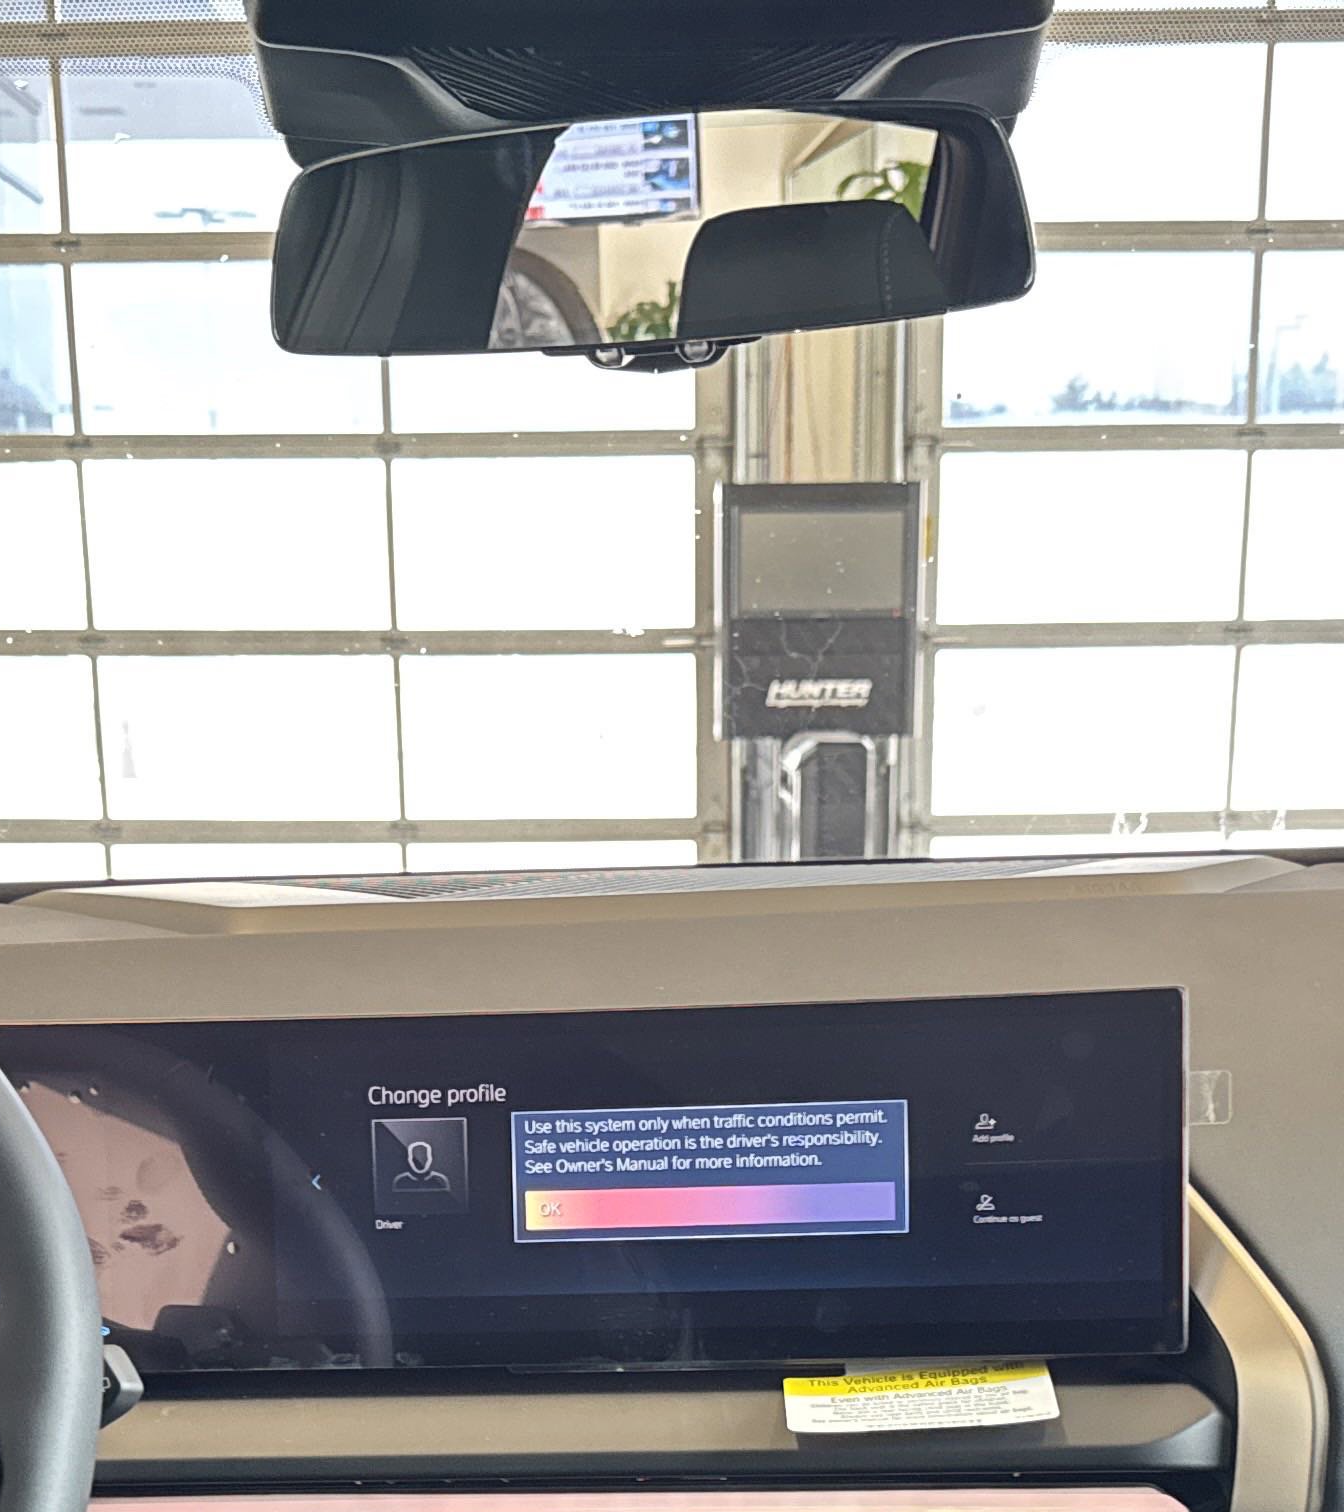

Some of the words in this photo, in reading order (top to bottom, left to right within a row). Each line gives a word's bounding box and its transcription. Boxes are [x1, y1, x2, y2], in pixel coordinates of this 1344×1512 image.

[765, 678, 873, 703] HUNTER
[367, 1085, 442, 1108] Change
[447, 1083, 507, 1106] profile
[524, 1120, 552, 1134] Use
[555, 1119, 583, 1133] this
[584, 1118, 635, 1136] system
[638, 1116, 669, 1136] only
[672, 1115, 710, 1130] when
[713, 1113, 755, 1129] traffic
[757, 1111, 834, 1128] conditions
[836, 1109, 888, 1128] permit.
[524, 1140, 557, 1154] Safe
[559, 1138, 610, 1154] vehicle
[612, 1137, 681, 1154] operation
[684, 1136, 697, 1149] is
[699, 1135, 724, 1149] the
[726, 1133, 780, 1149] driver's
[782, 1130, 883, 1148] responsibility.
[524, 1160, 553, 1174] See
[555, 1159, 613, 1174] Owner's
[616, 1156, 668, 1172] Manual
[672, 1155, 691, 1170] for
[695, 1157, 733, 1170] more
[735, 1153, 823, 1169] information.
[539, 1203, 562, 1217] OK
[375, 1219, 404, 1230] Driver
[808, 1378, 839, 1388] This
[842, 1375, 896, 1386] Vehicle
[919, 1365, 989, 1381] Equipped
[847, 1382, 921, 1393] Advanced
[926, 1379, 946, 1388] Air
[951, 1375, 988, 1387] Bags
[893, 1388, 953, 1400] Advanced
[956, 1387, 973, 1396] Air
